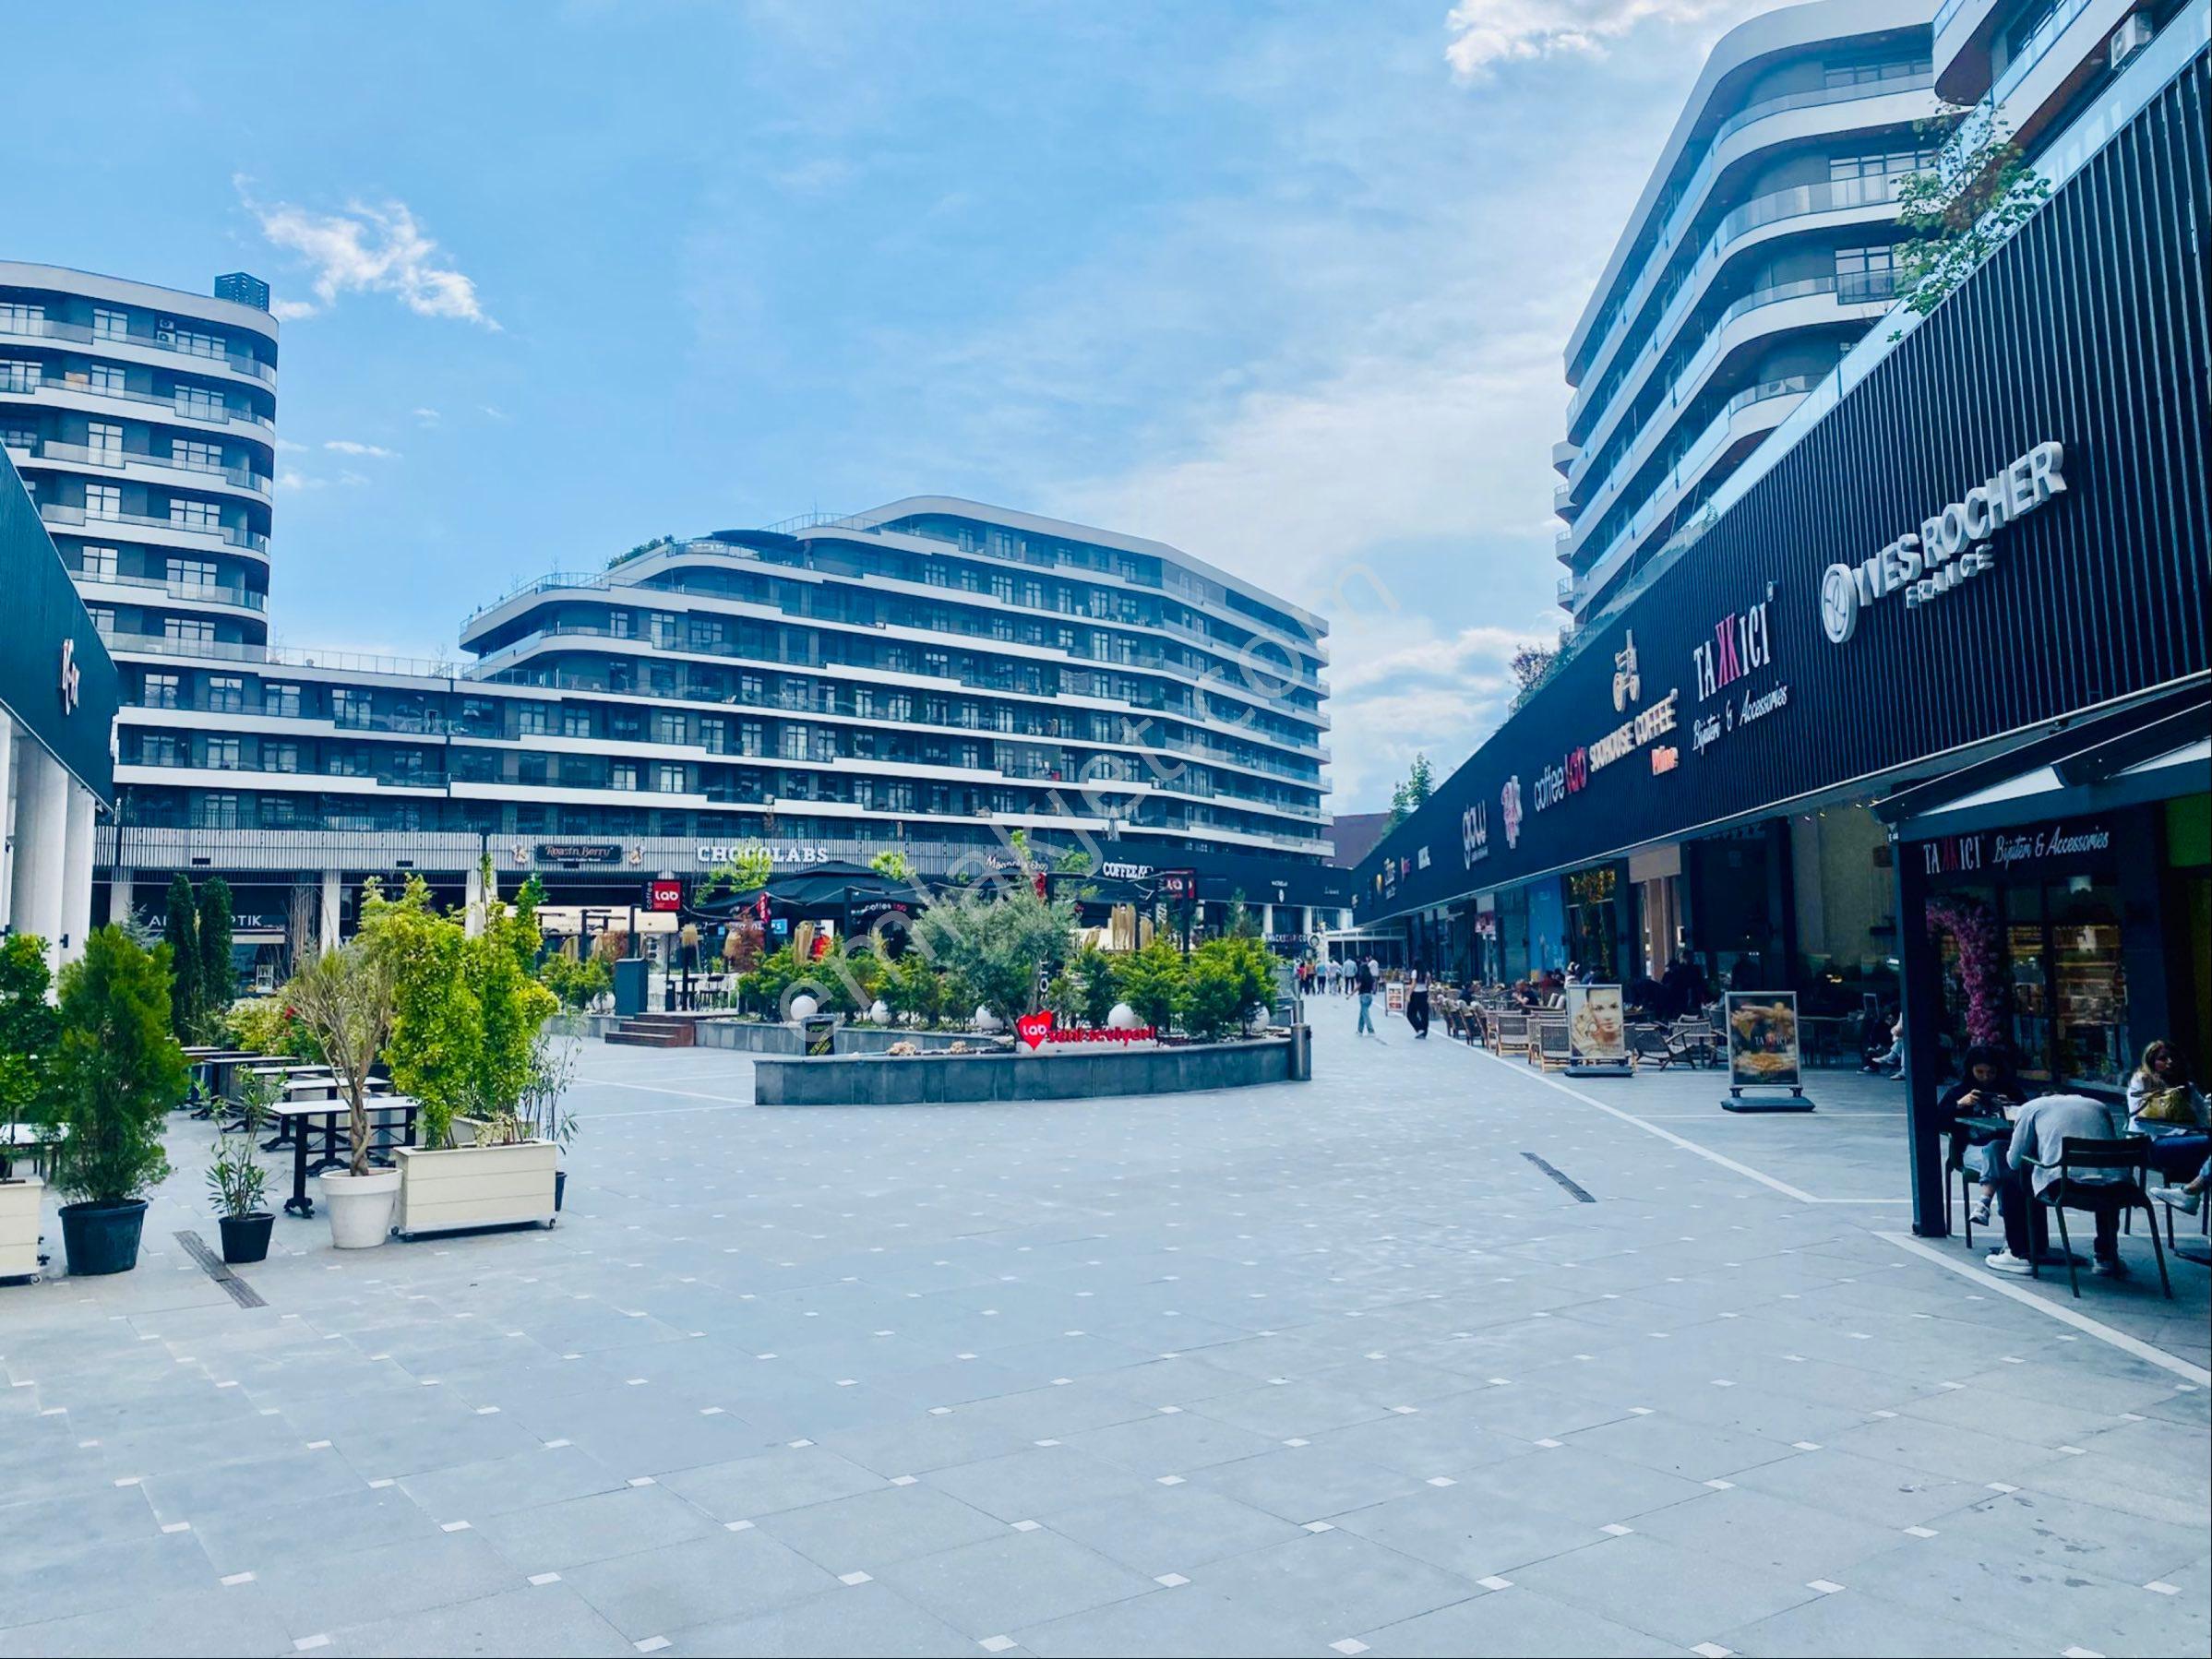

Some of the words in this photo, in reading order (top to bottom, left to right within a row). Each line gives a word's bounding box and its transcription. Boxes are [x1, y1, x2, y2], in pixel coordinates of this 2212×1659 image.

[1852, 533, 1921, 607] YVES
[1921, 441, 2067, 568] ROCHER
[1906, 543, 1994, 609] FRANCE
[1740, 680, 1788, 726] Accessories
[1534, 765, 1565, 812] coffee
[2046, 826, 2110, 856] Accessories
[654, 890, 679, 901] lab
[1022, 1025, 1047, 1035] lab
